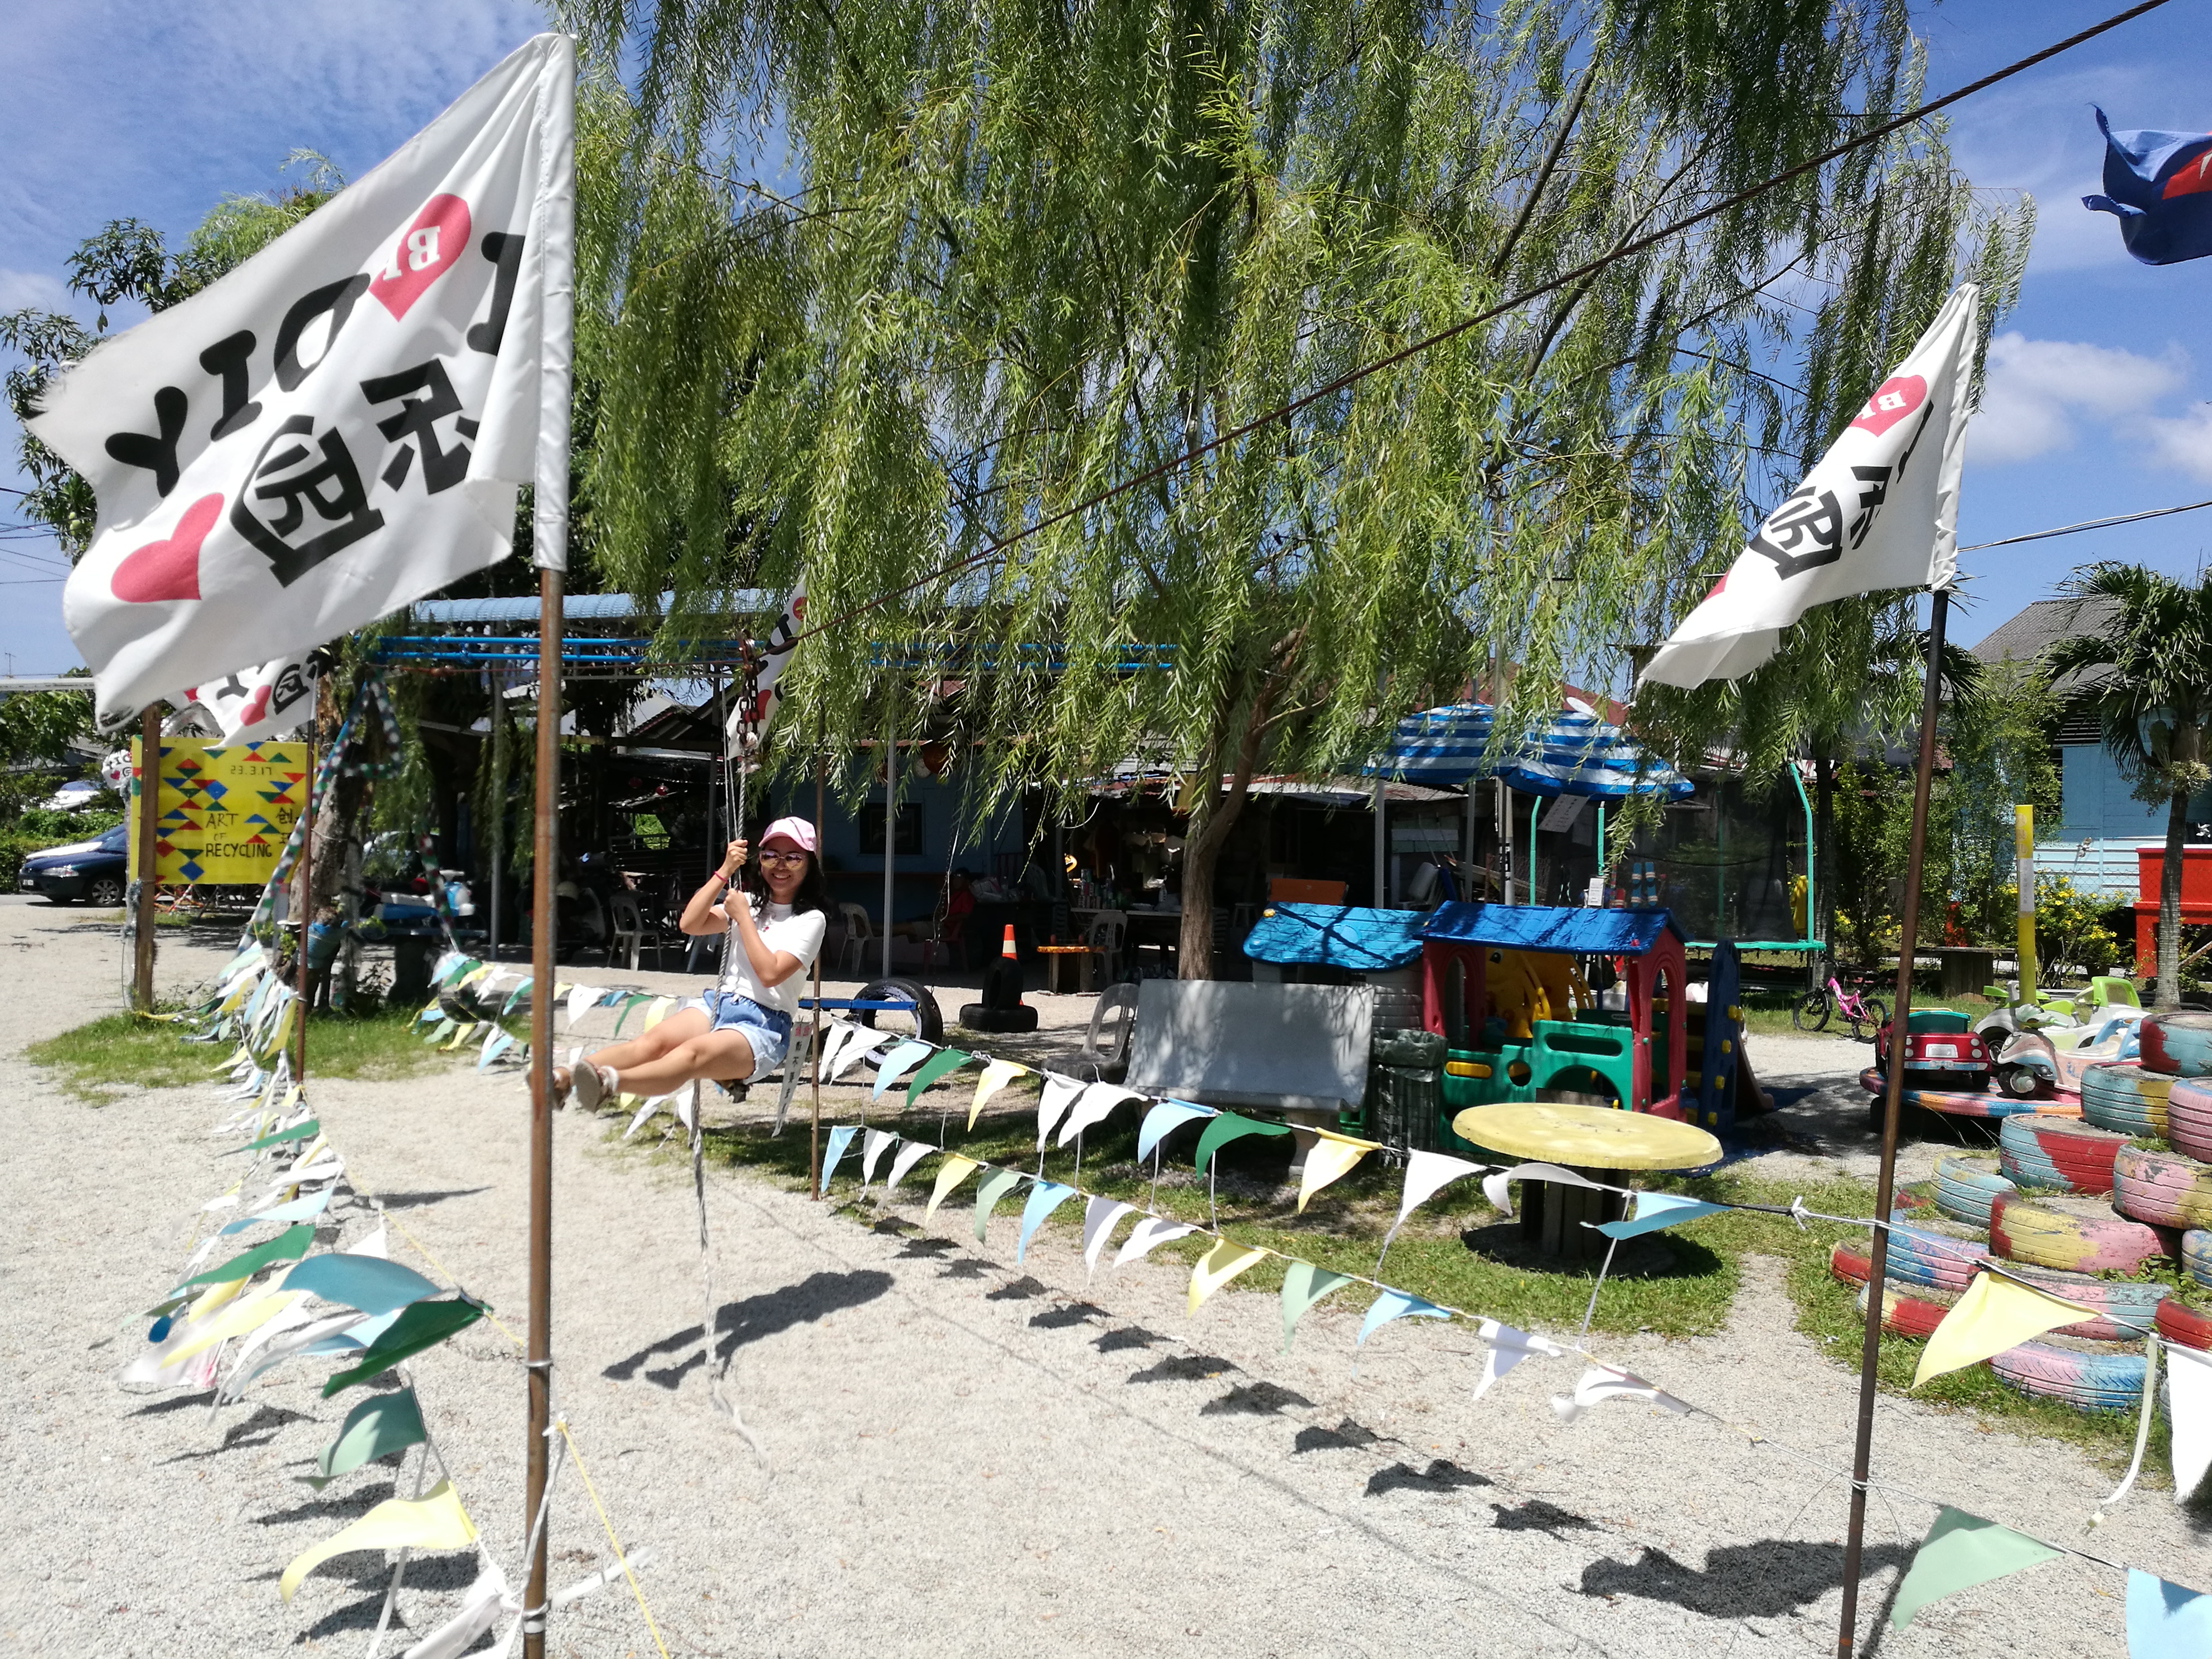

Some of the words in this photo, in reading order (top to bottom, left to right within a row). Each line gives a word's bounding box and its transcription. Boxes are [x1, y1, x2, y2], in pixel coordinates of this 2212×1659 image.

[230, 765, 272, 775] 23.3.17
[205, 813, 239, 830] ART
[205, 843, 273, 858] RECYCLING
